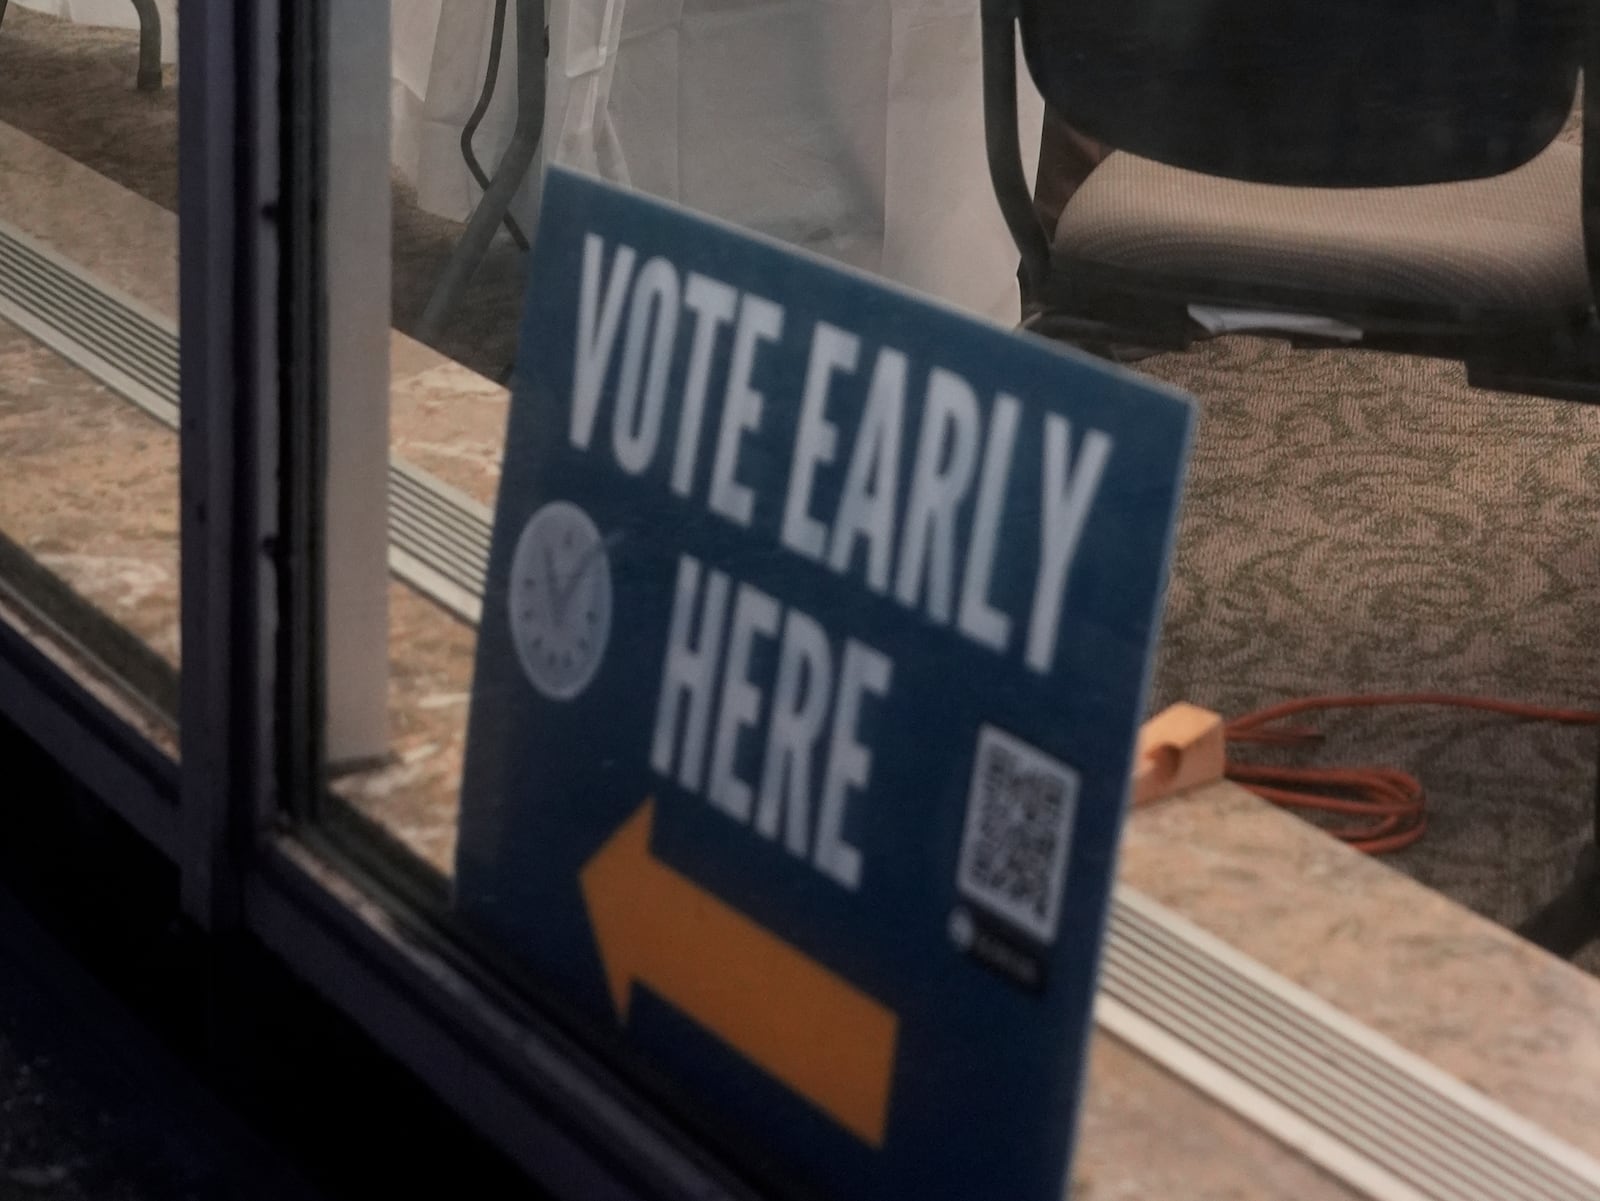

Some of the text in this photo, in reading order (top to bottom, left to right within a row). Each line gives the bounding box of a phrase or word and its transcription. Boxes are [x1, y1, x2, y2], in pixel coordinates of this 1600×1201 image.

[569, 232, 1113, 676] VOTE EARLY
[650, 553, 893, 891] HERE
